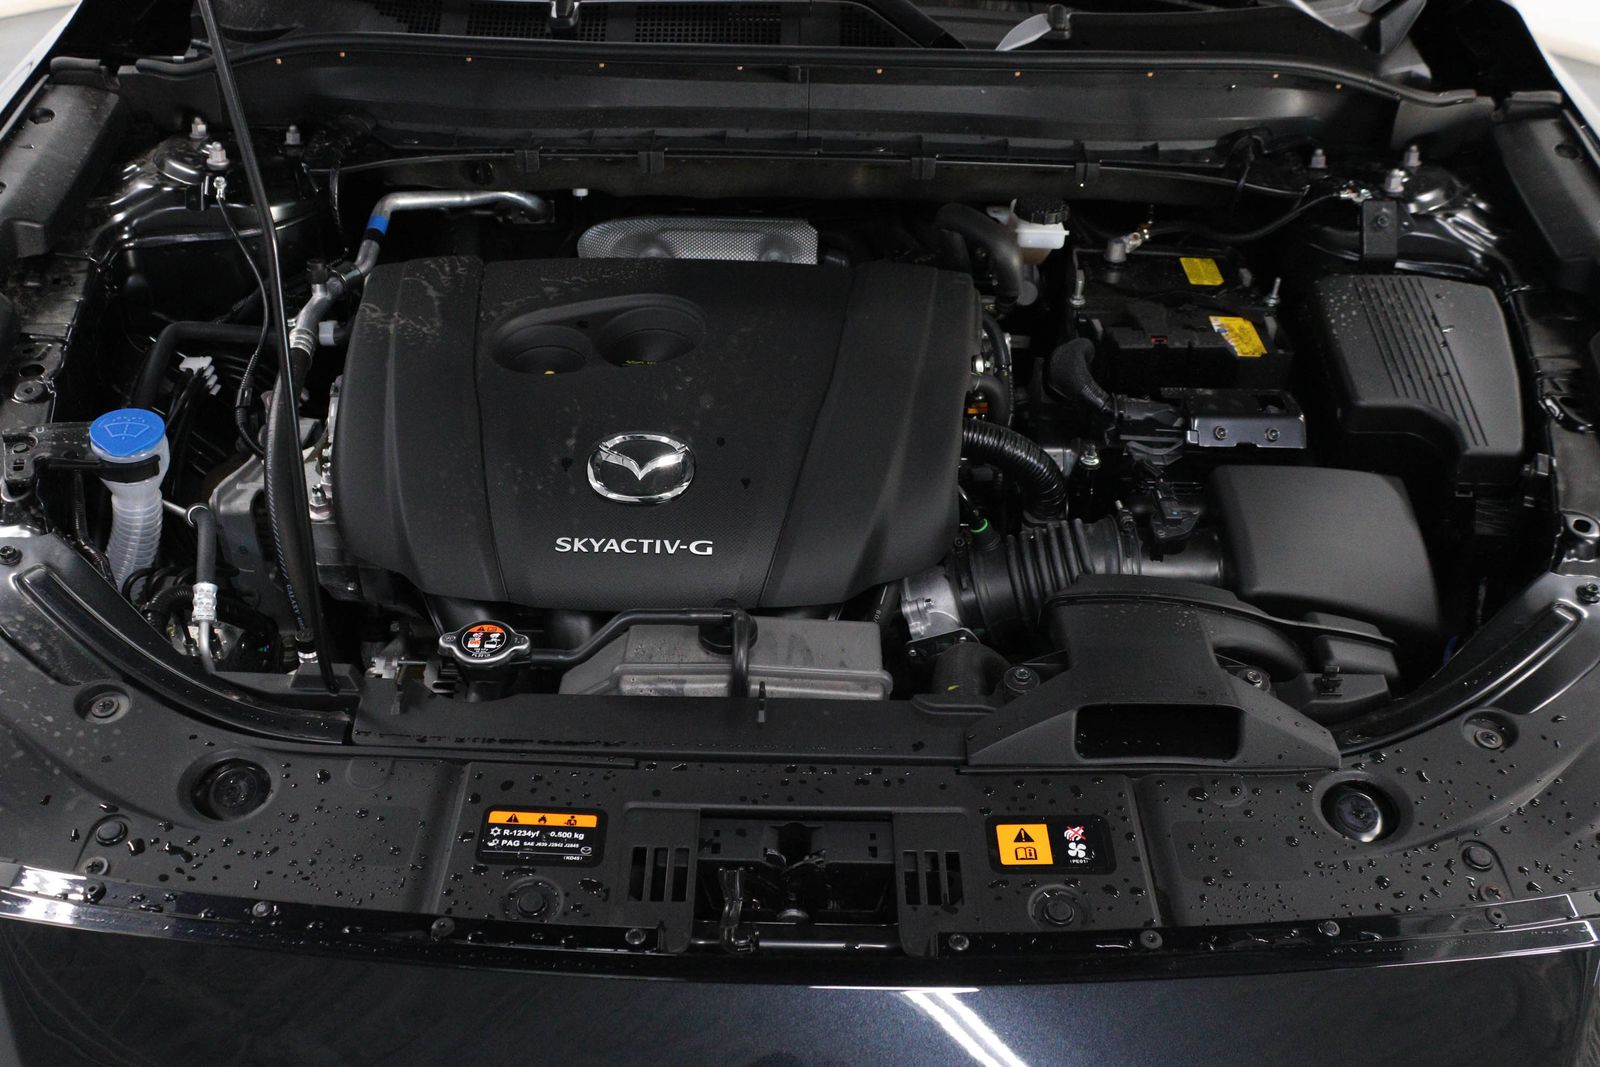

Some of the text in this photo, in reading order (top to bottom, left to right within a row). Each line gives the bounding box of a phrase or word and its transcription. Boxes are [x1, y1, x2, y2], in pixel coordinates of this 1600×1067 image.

[554, 536, 714, 556] SKYACTIV-G
[503, 829, 540, 838] R-1234yf
[573, 832, 585, 840] kg
[501, 839, 520, 847] PAG
